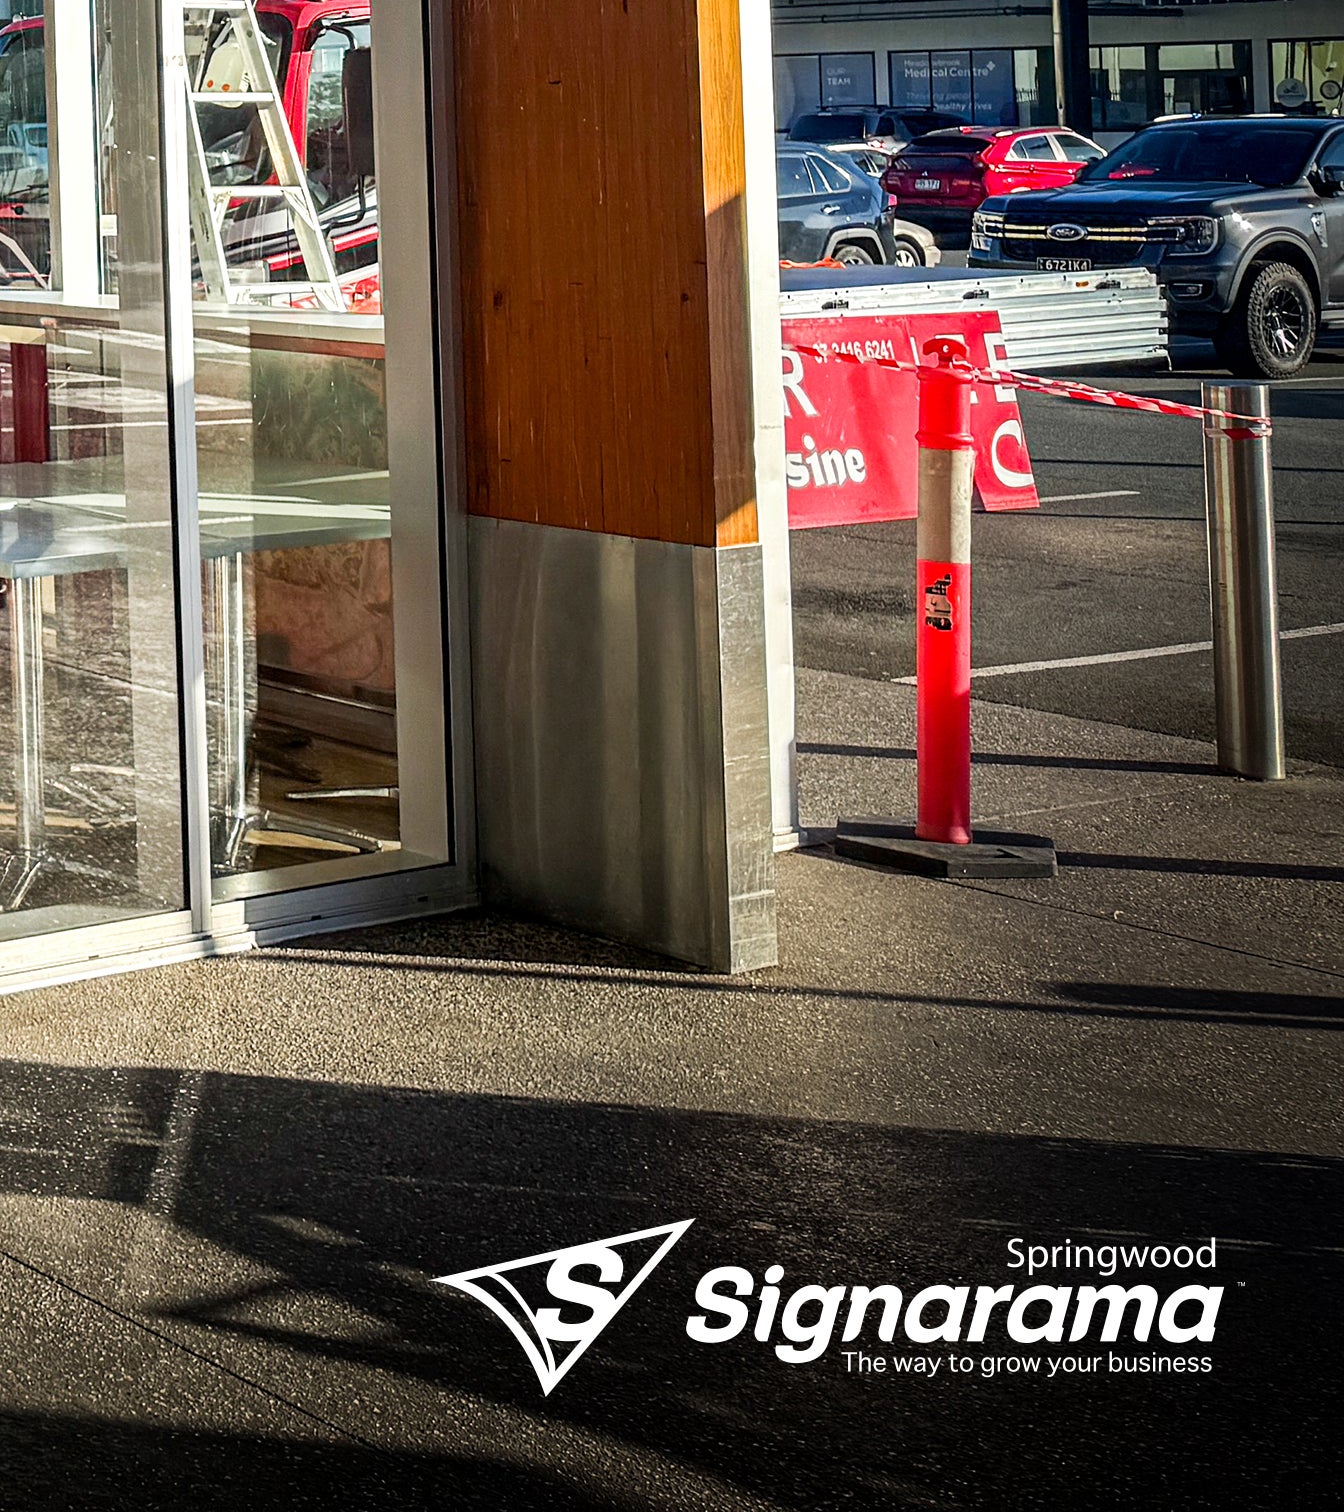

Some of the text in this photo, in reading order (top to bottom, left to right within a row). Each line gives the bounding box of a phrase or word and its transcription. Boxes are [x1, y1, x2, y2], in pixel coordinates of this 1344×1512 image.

[904, 67, 989, 78] Medical Centre
[827, 77, 850, 85] TEAM
[864, 339, 895, 361] 6241
[786, 434, 866, 489] sine
